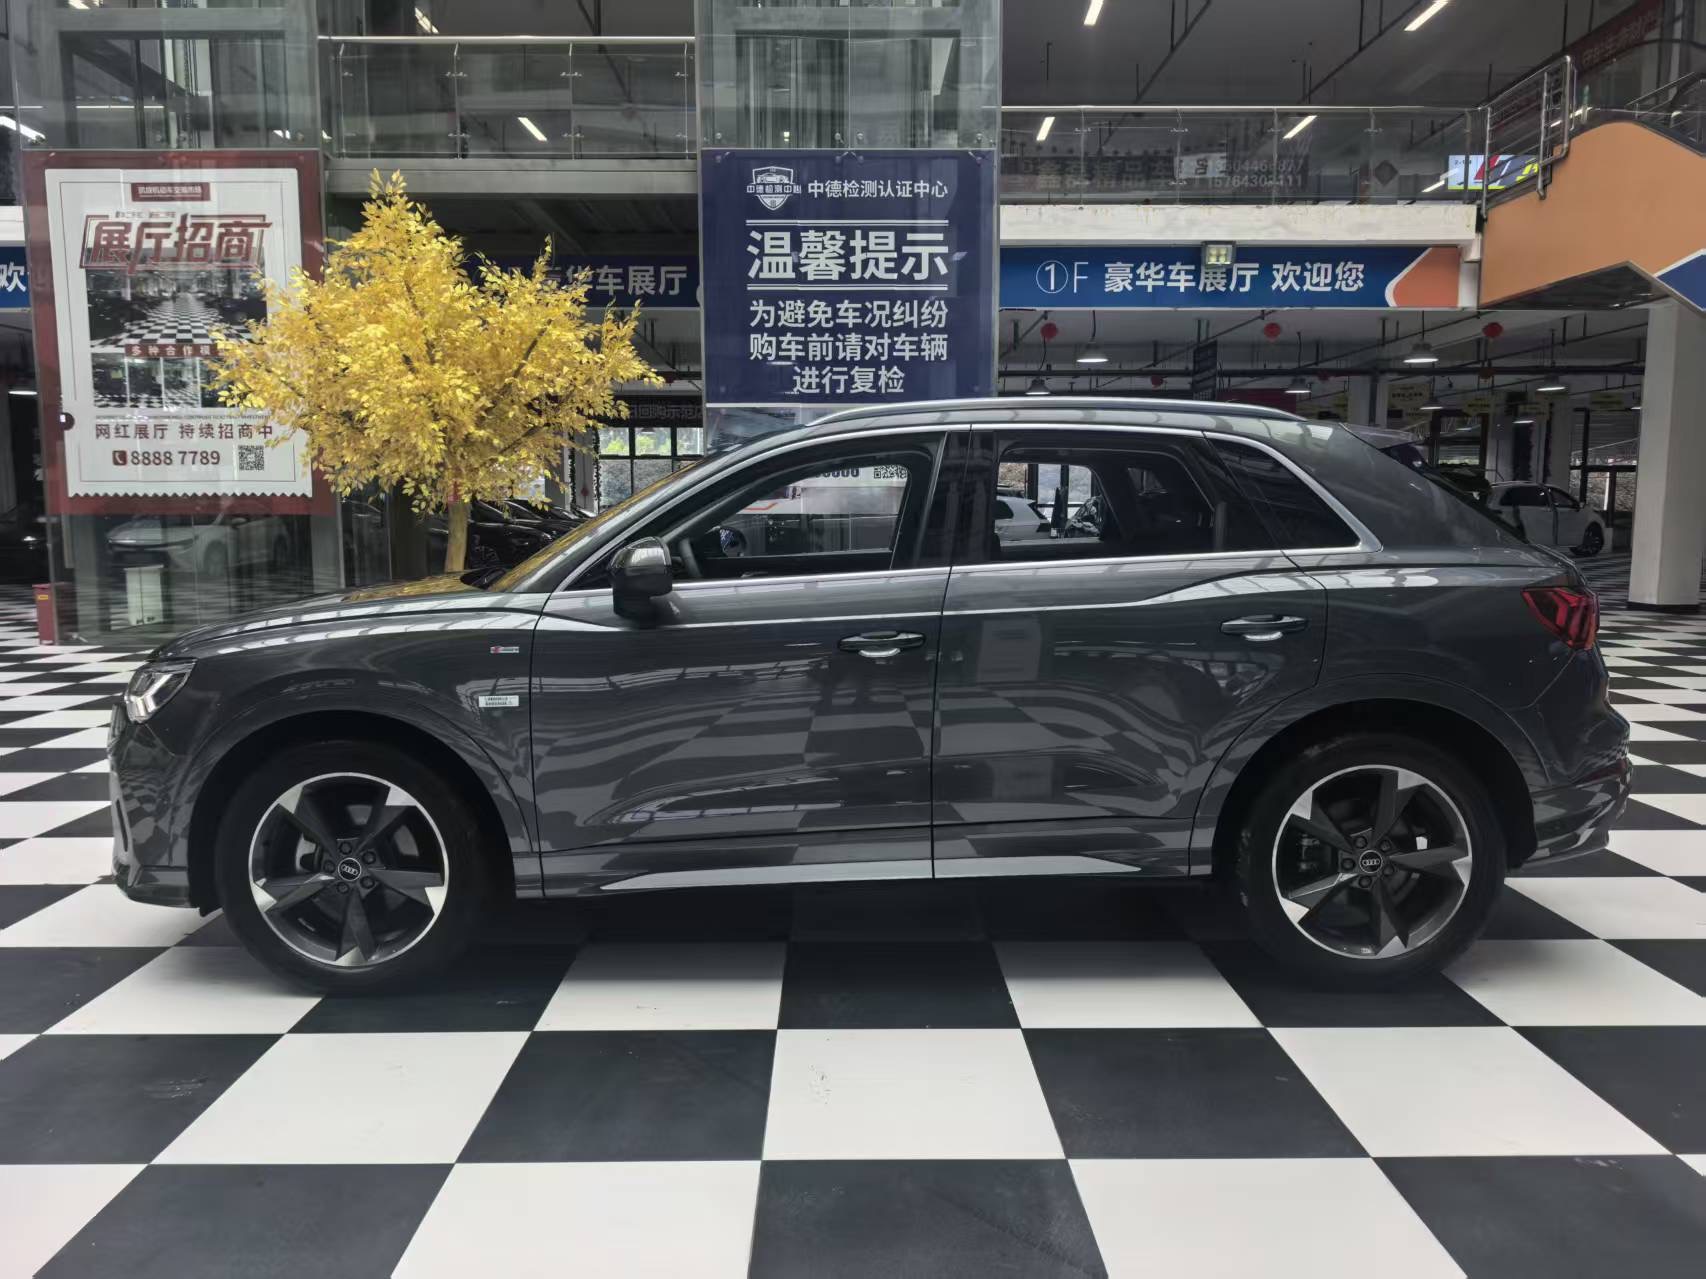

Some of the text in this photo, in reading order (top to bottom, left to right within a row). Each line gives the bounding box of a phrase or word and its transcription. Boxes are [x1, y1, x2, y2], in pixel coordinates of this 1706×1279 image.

[807, 180, 949, 198] 中德检测认证中心
[91, 213, 272, 274] 展厅招商
[746, 230, 949, 281] 温馨提示
[1104, 262, 1260, 293] 豪华车展厅
[1271, 261, 1365, 292] 欢迎您
[750, 300, 949, 329] 为避免车况纠纷
[131, 345, 225, 356] 多种合作模
[750, 333, 948, 361] 购车前请对车辆
[793, 366, 905, 394] 进行复检
[95, 423, 273, 439] 网红展厅 持续招商中
[130, 450, 221, 466] 8888 7789
